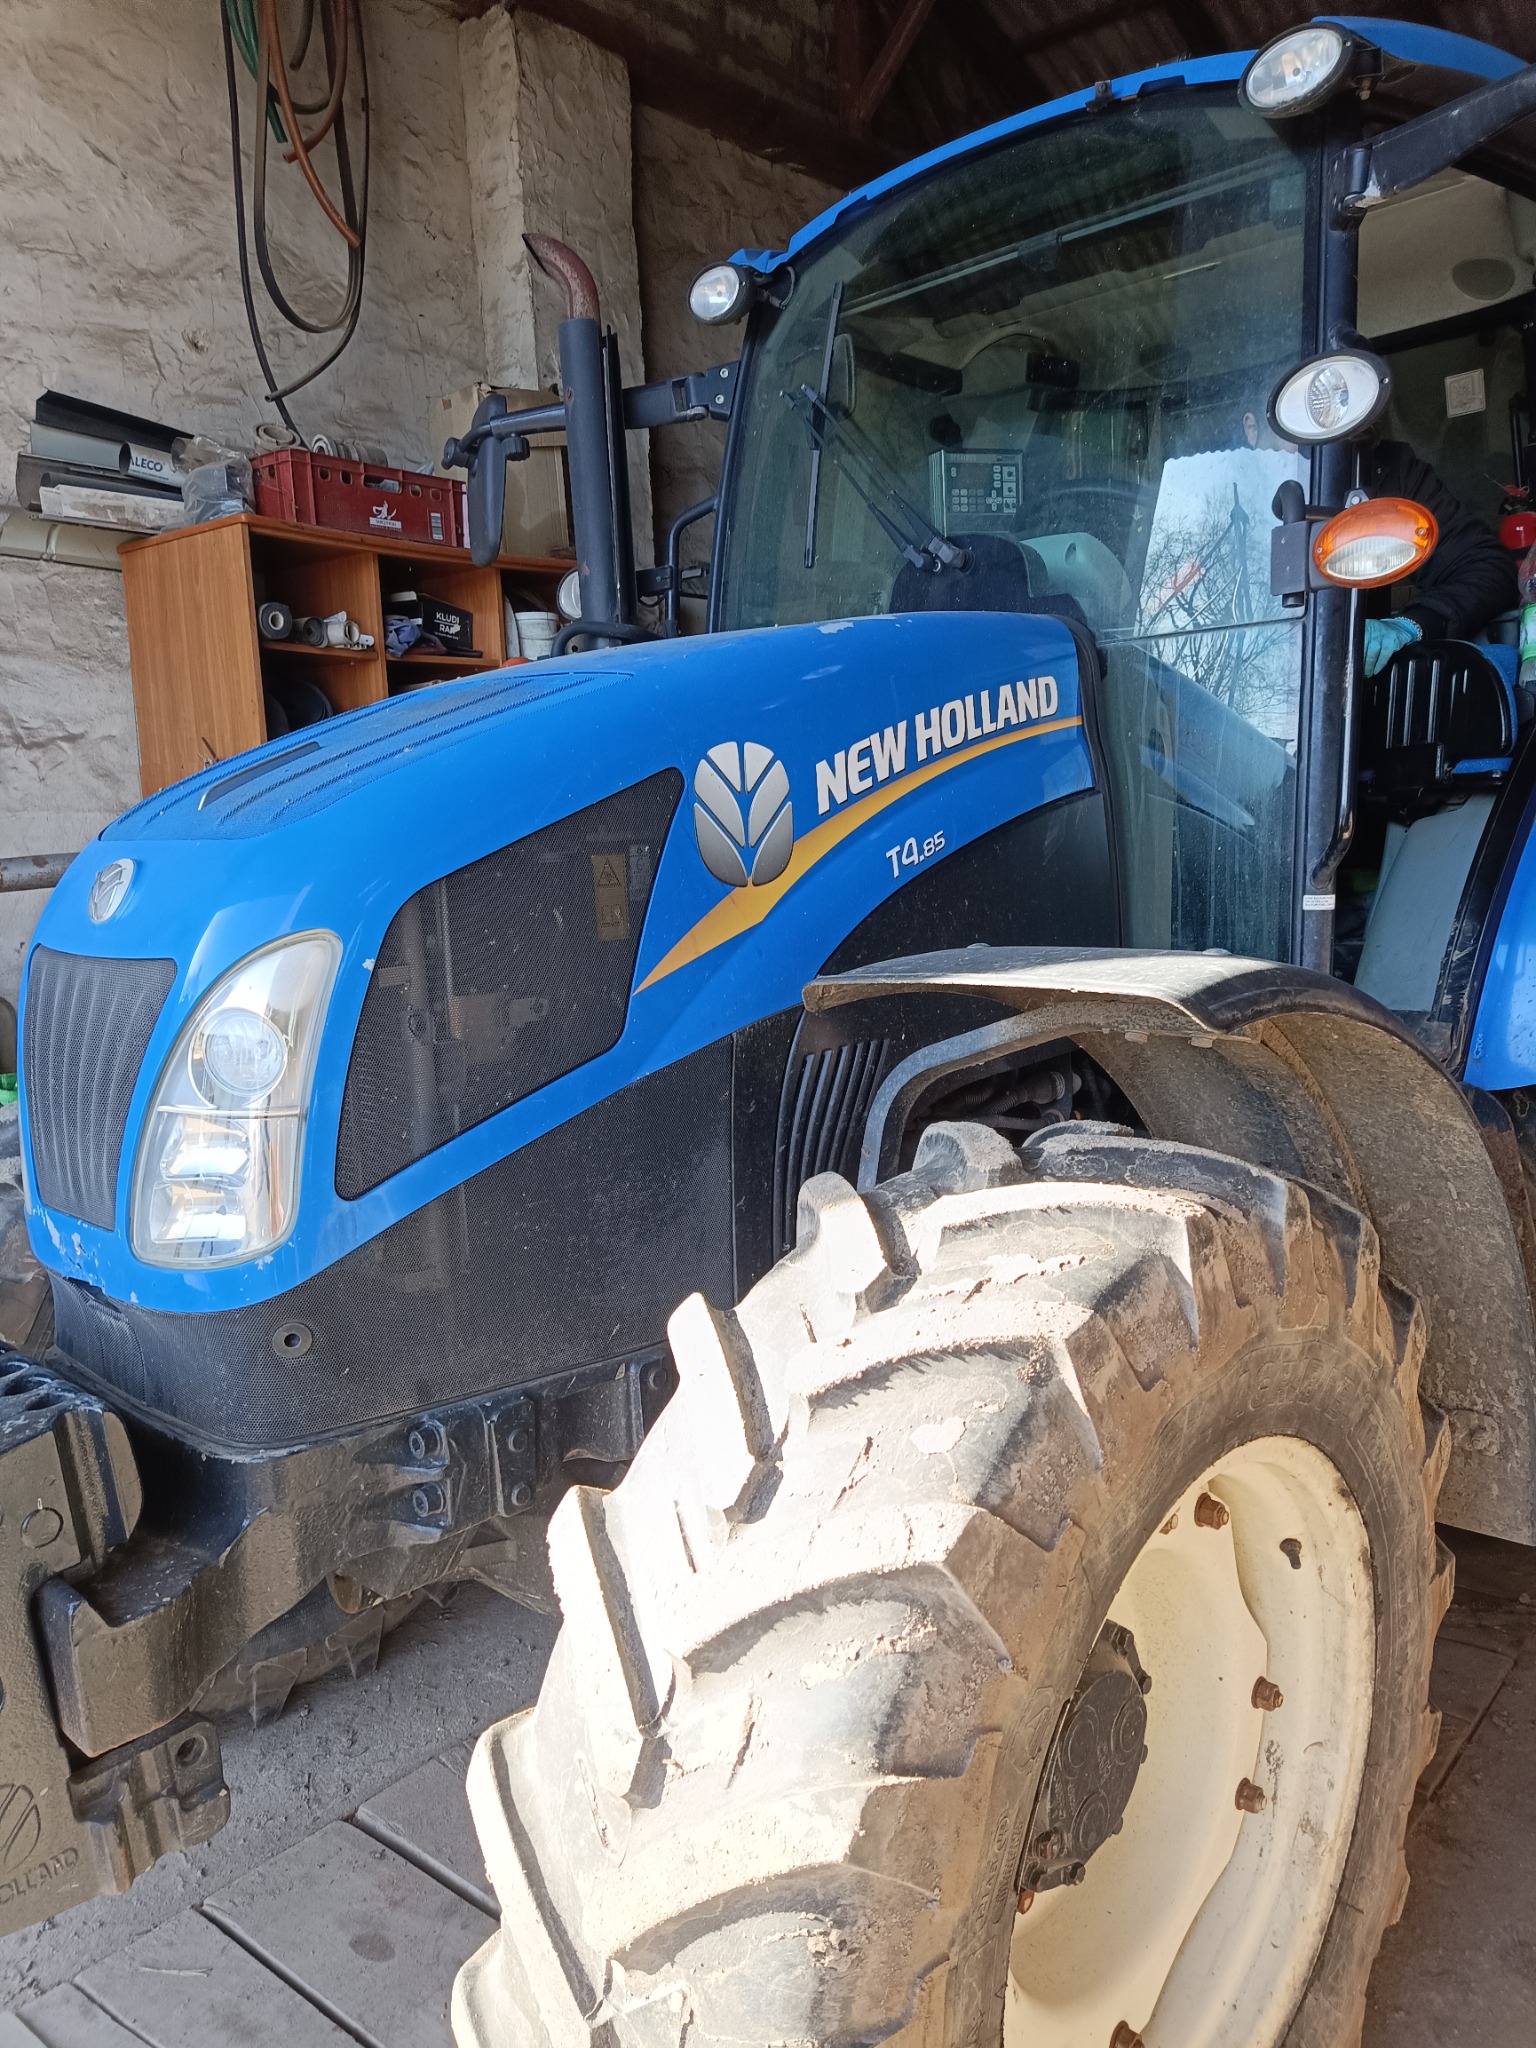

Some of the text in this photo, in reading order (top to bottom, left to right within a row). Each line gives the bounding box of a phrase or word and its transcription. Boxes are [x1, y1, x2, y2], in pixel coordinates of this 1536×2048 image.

[436, 611, 460, 624] KLUDI
[815, 675, 1059, 816] NEW HOLLAND
[885, 829, 946, 879] T4.85
